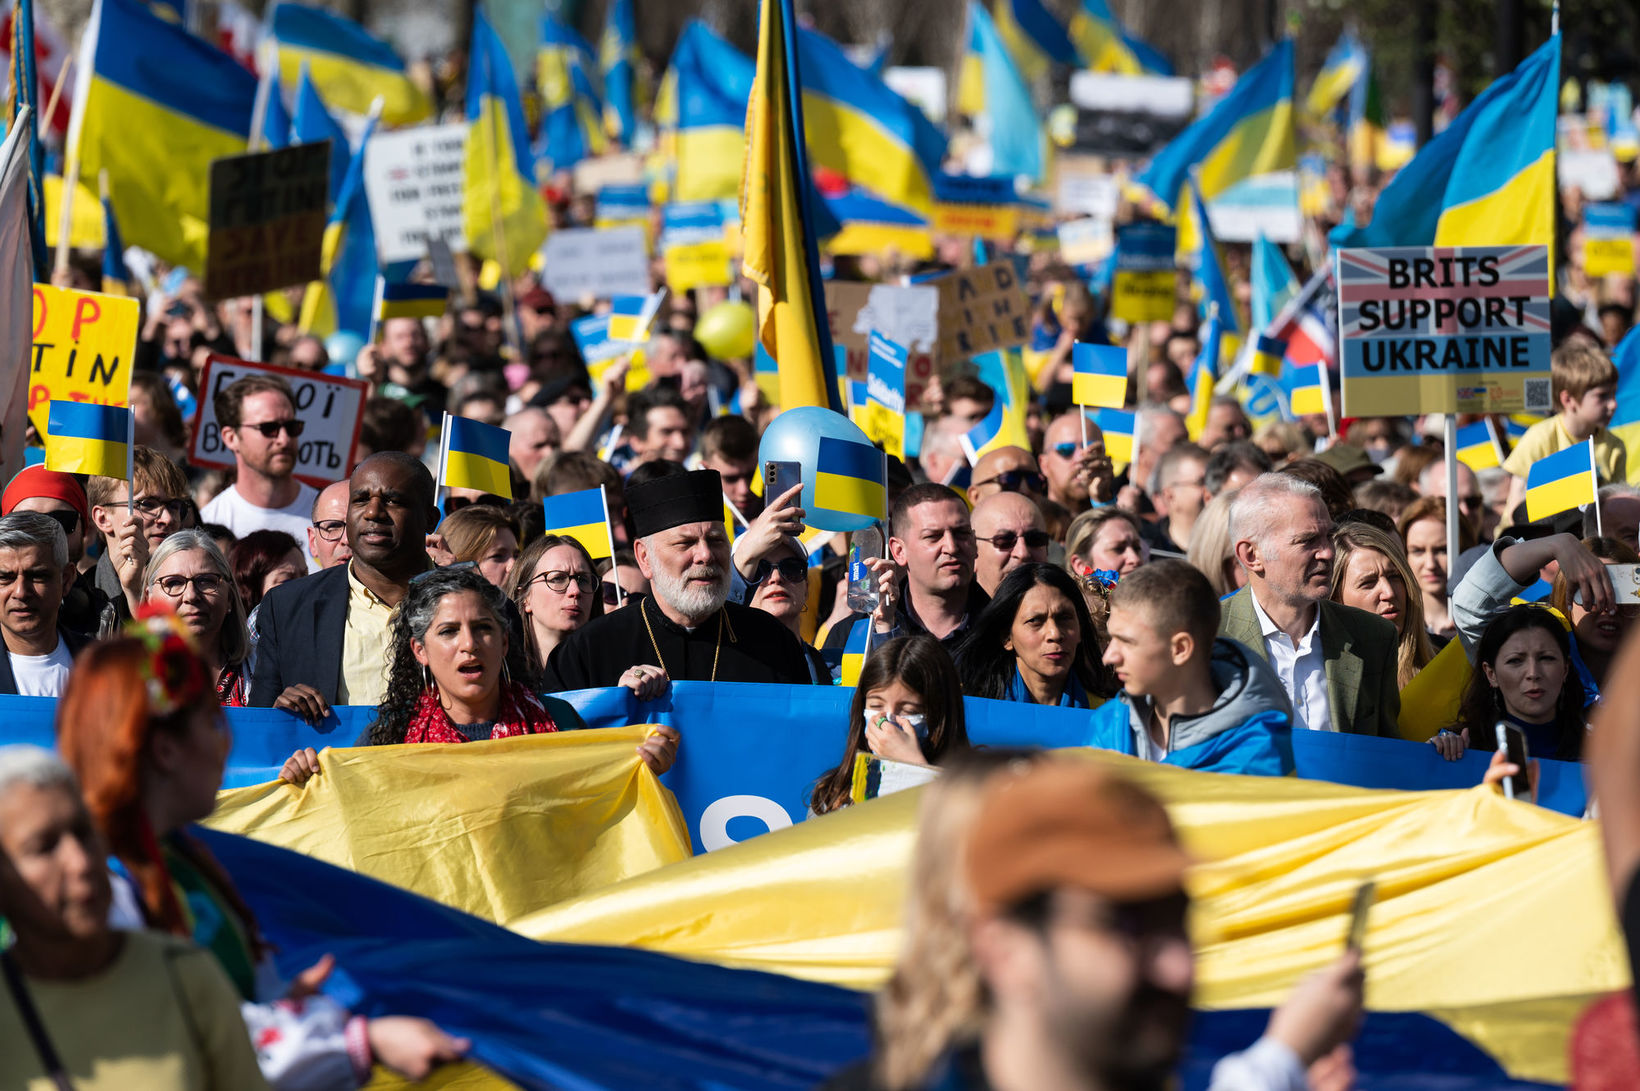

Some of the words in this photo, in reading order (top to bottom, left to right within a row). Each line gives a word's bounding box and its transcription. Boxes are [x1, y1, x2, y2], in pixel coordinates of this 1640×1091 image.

[1388, 256, 1500, 290] BRITS
[1358, 296, 1531, 331] SUPPORT
[32, 339, 119, 386] TIN
[1361, 336, 1531, 372] UKRAINE
